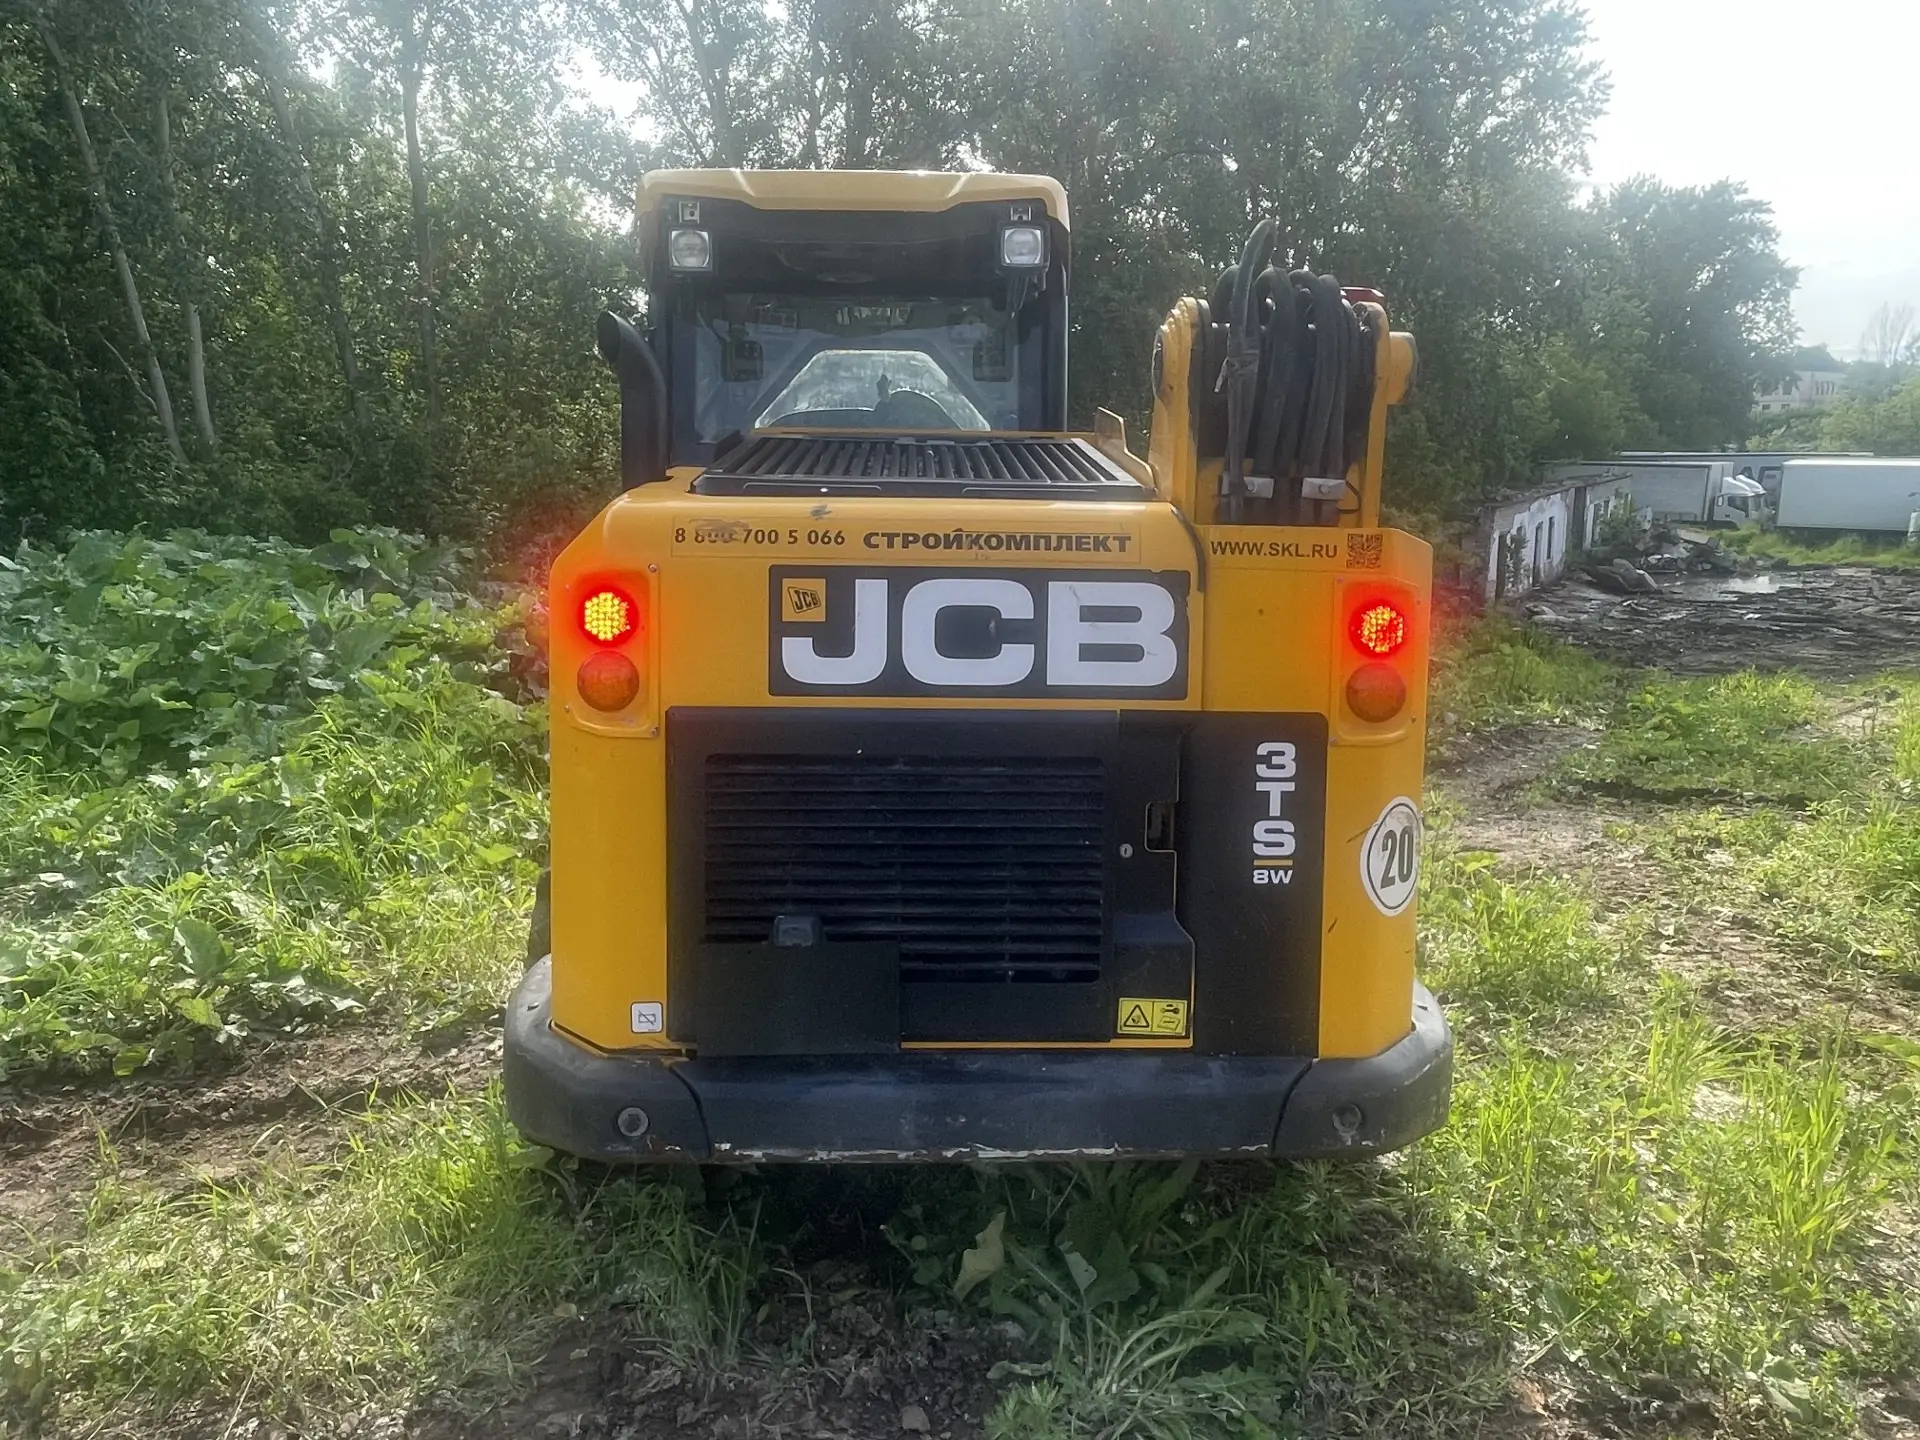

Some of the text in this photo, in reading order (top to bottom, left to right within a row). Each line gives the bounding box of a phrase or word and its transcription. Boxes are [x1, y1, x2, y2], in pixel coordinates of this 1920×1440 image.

[675, 527, 686, 544] 8
[742, 528, 779, 545] 700
[787, 529, 799, 545] 5
[807, 529, 846, 546] 066
[863, 528, 1132, 552] СТРОЙКОМПЛЕКТ
[1210, 541, 1338, 559] WWW.SKL.RU
[793, 589, 819, 611] JCB
[781, 578, 1178, 686] JCB
[1380, 825, 1414, 890] 20
[1252, 869, 1293, 884] 8W
